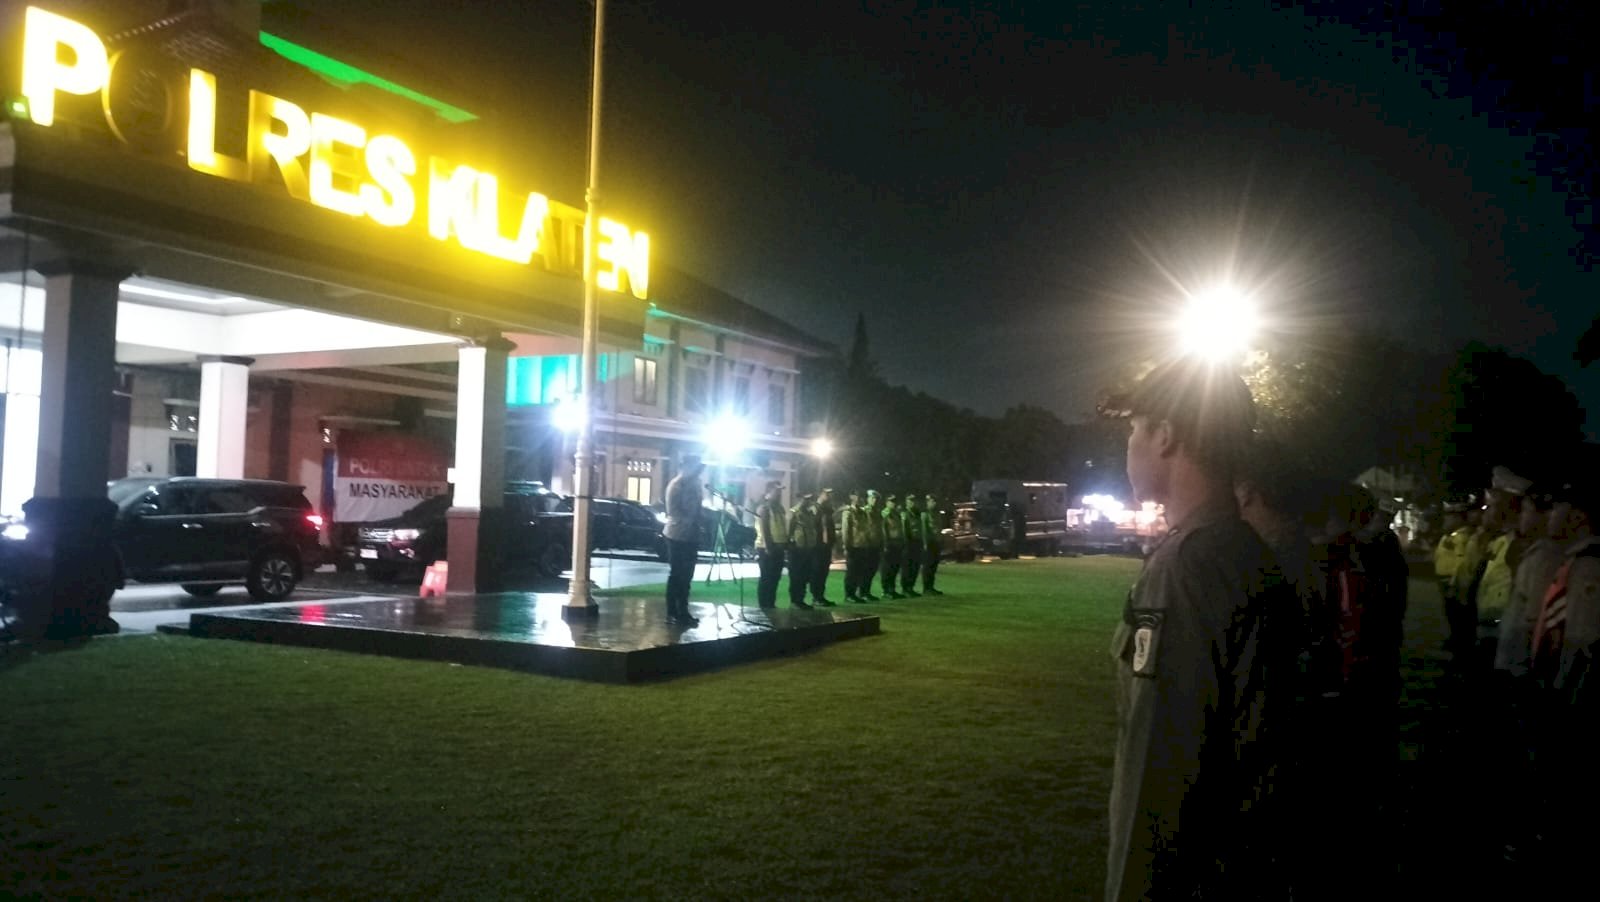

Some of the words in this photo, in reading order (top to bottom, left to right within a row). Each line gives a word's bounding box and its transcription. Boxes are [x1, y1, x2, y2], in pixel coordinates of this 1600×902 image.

[21, 6, 416, 227] POLRES
[427, 155, 650, 299] KLATEN
[349, 482, 440, 499] MASYARAKAT
